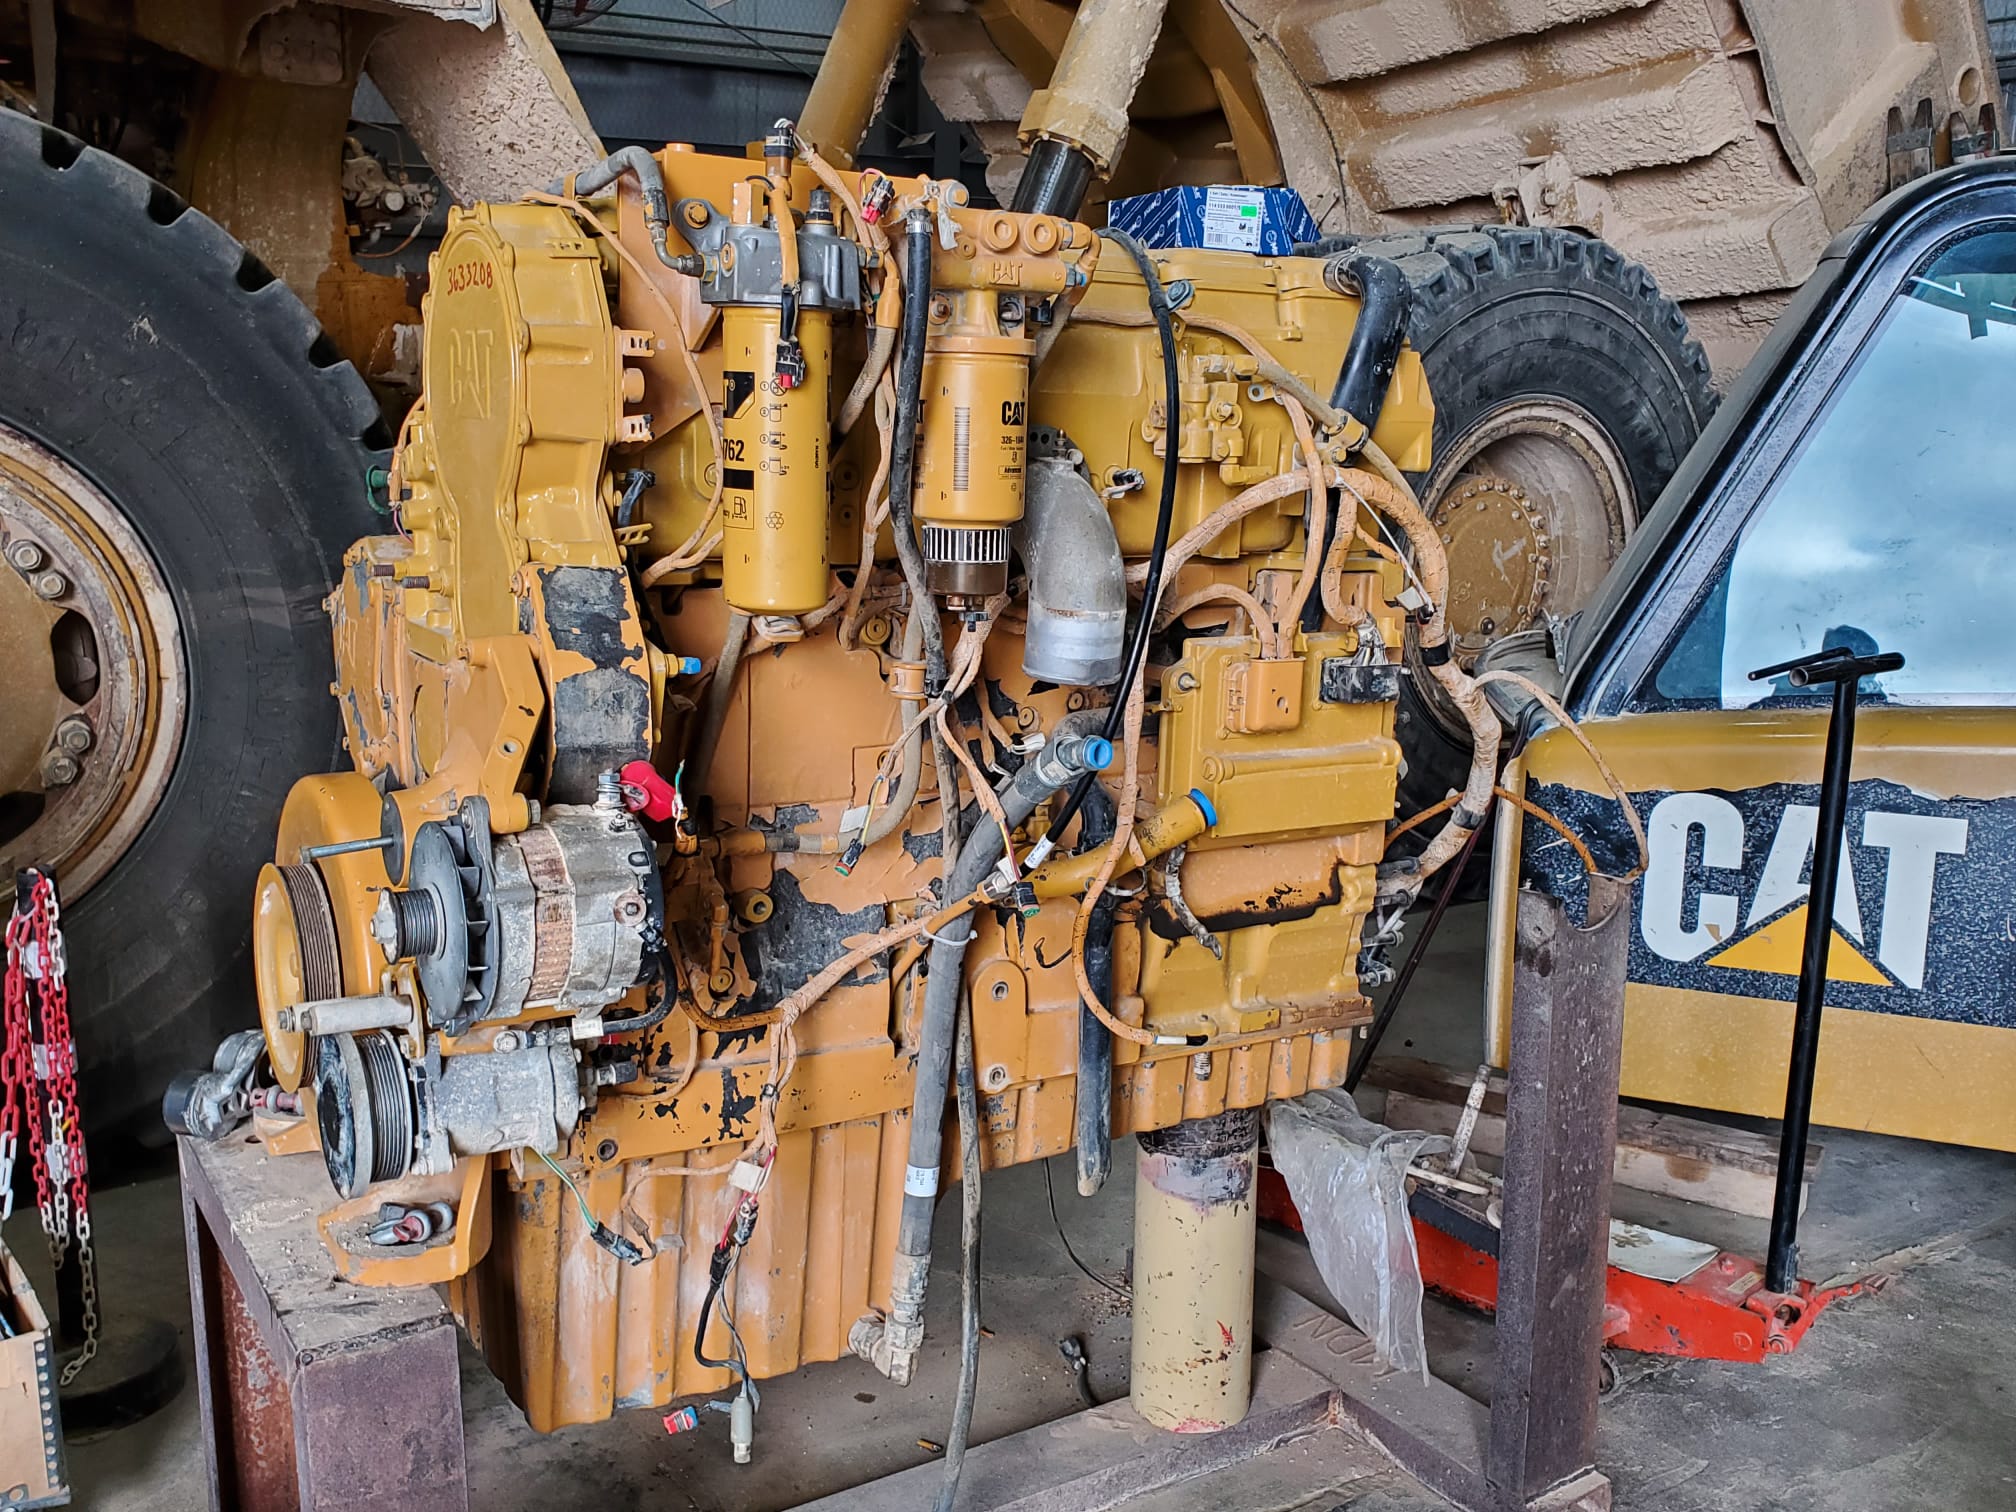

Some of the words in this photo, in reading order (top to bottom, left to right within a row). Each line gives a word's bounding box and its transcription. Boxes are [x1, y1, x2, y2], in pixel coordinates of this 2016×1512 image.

[447, 261, 493, 296] 3633208
[989, 259, 1023, 287] CAT
[449, 327, 494, 420] CAT
[1002, 400, 1026, 426] CAT
[723, 438, 745, 462] 762
[1641, 792, 1969, 990] CAT
